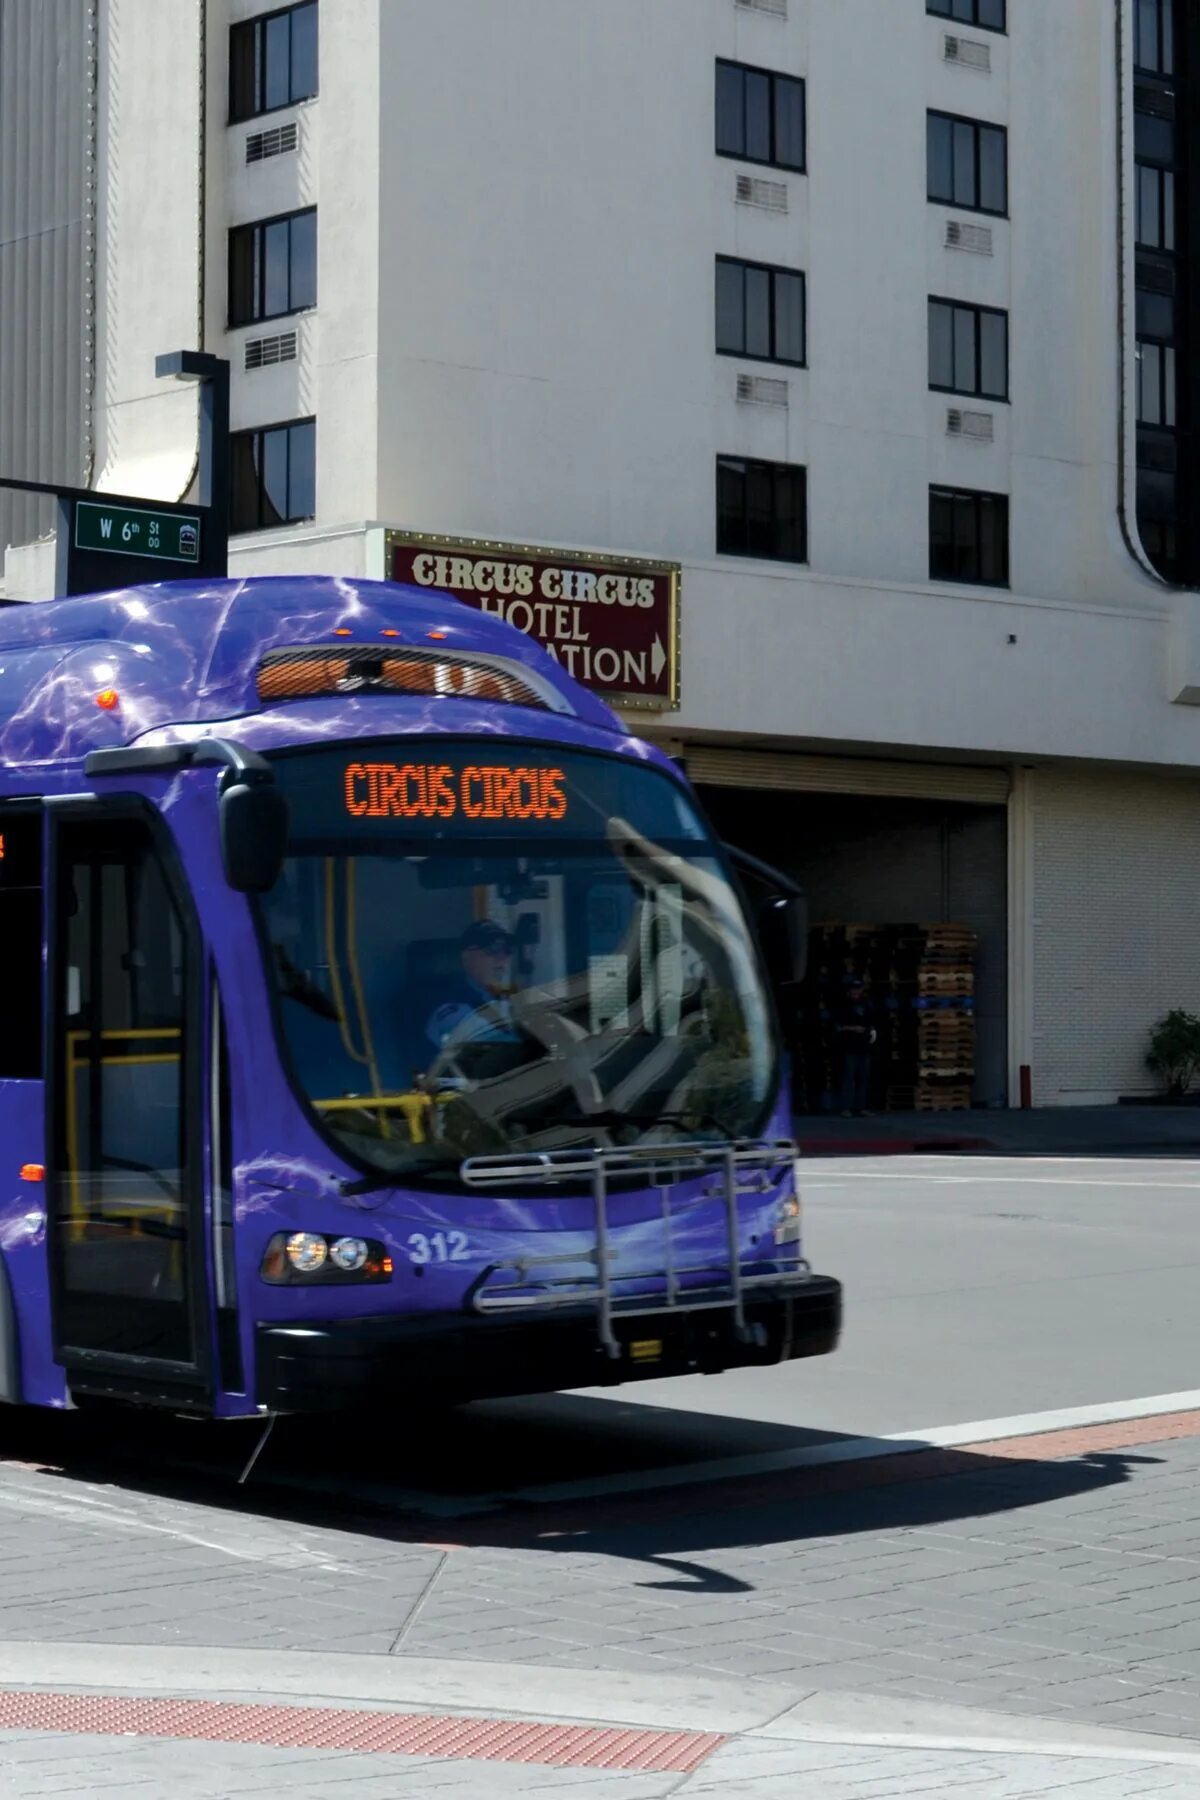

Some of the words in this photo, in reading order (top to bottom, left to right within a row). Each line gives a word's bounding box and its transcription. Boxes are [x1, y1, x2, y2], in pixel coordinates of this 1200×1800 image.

[100, 518, 112, 538] W
[122, 522, 140, 541] 6th
[149, 521, 160, 535] St
[411, 553, 533, 596] CIRCUS
[539, 567, 655, 609] CIRCUS
[480, 597, 590, 641] HOTEL
[344, 763, 456, 817] CIRCUS
[460, 766, 568, 819] CIRCUS
[407, 1231, 472, 1264] 312
